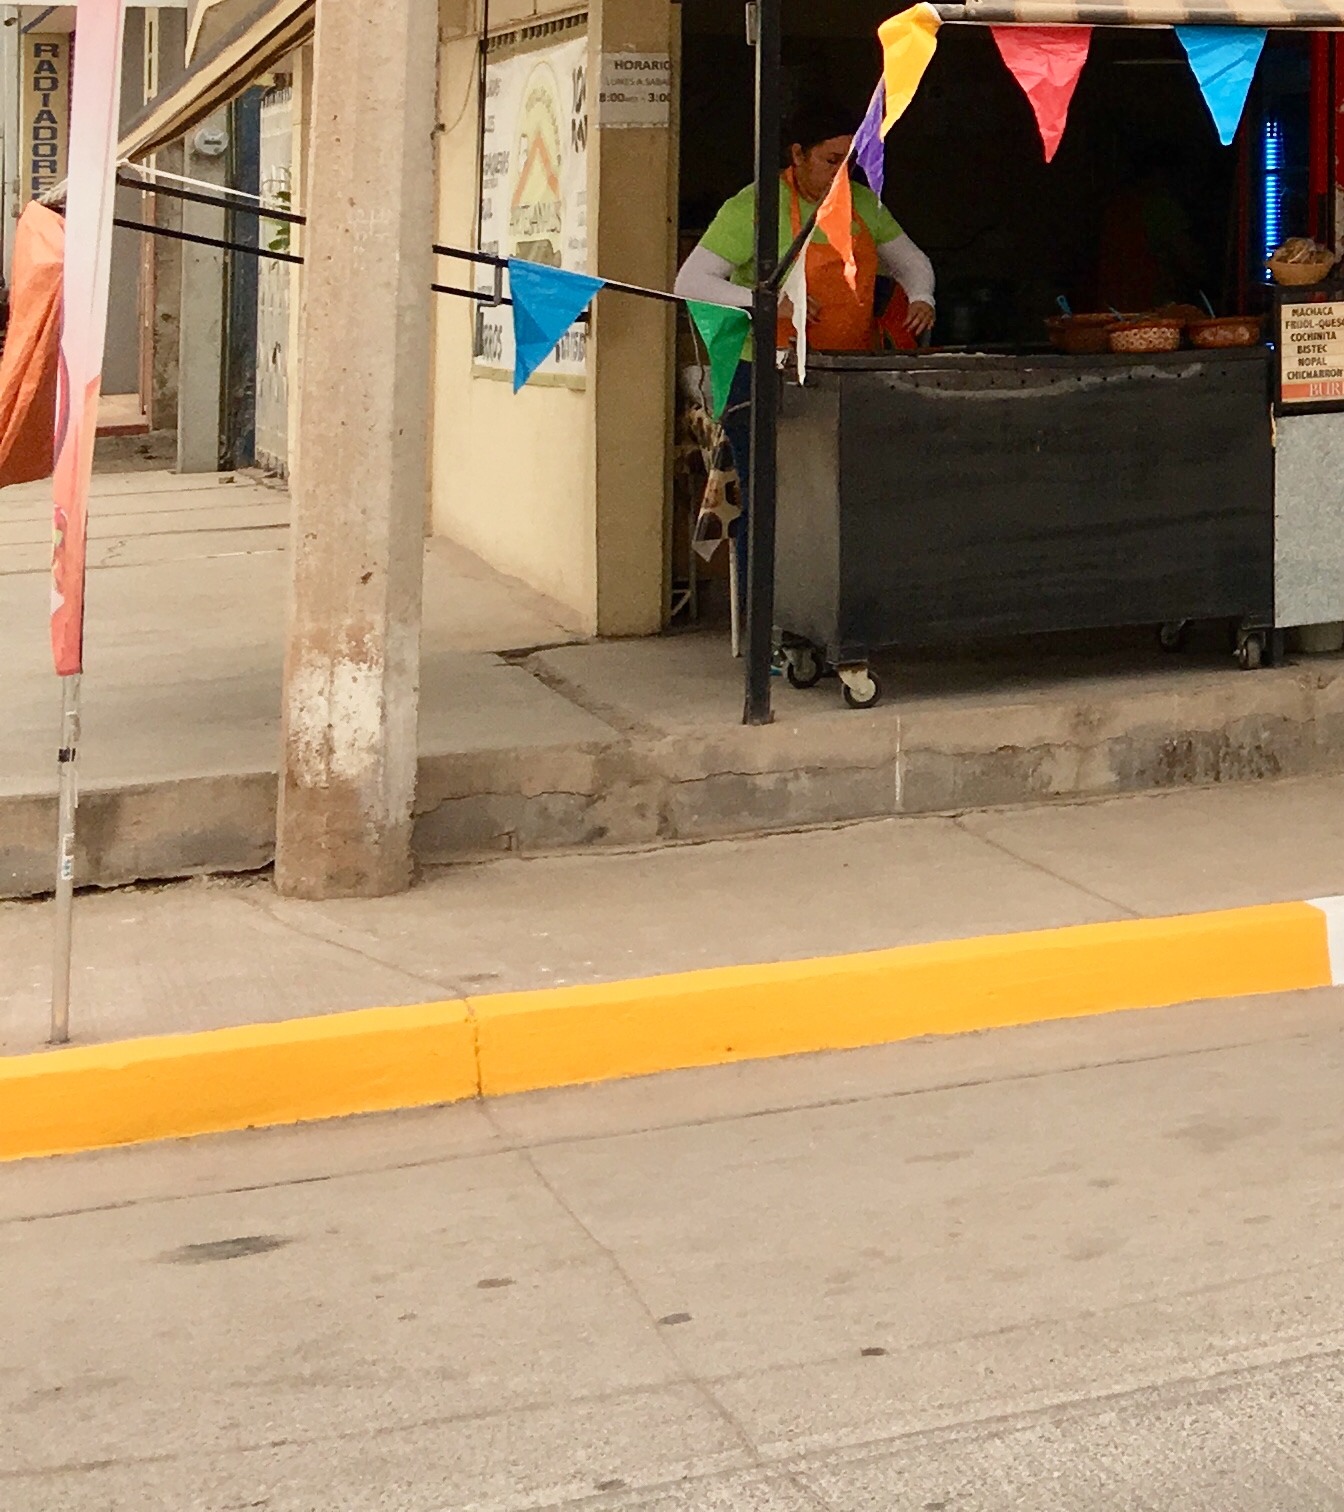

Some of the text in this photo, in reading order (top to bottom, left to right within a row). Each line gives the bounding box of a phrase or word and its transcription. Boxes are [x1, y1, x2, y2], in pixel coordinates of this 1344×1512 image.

[1291, 306, 1333, 317] MACHACA
[1290, 331, 1337, 342] COCHINITA
[1297, 344, 1328, 354] BISTEC
[1297, 356, 1328, 367] NOPAL
